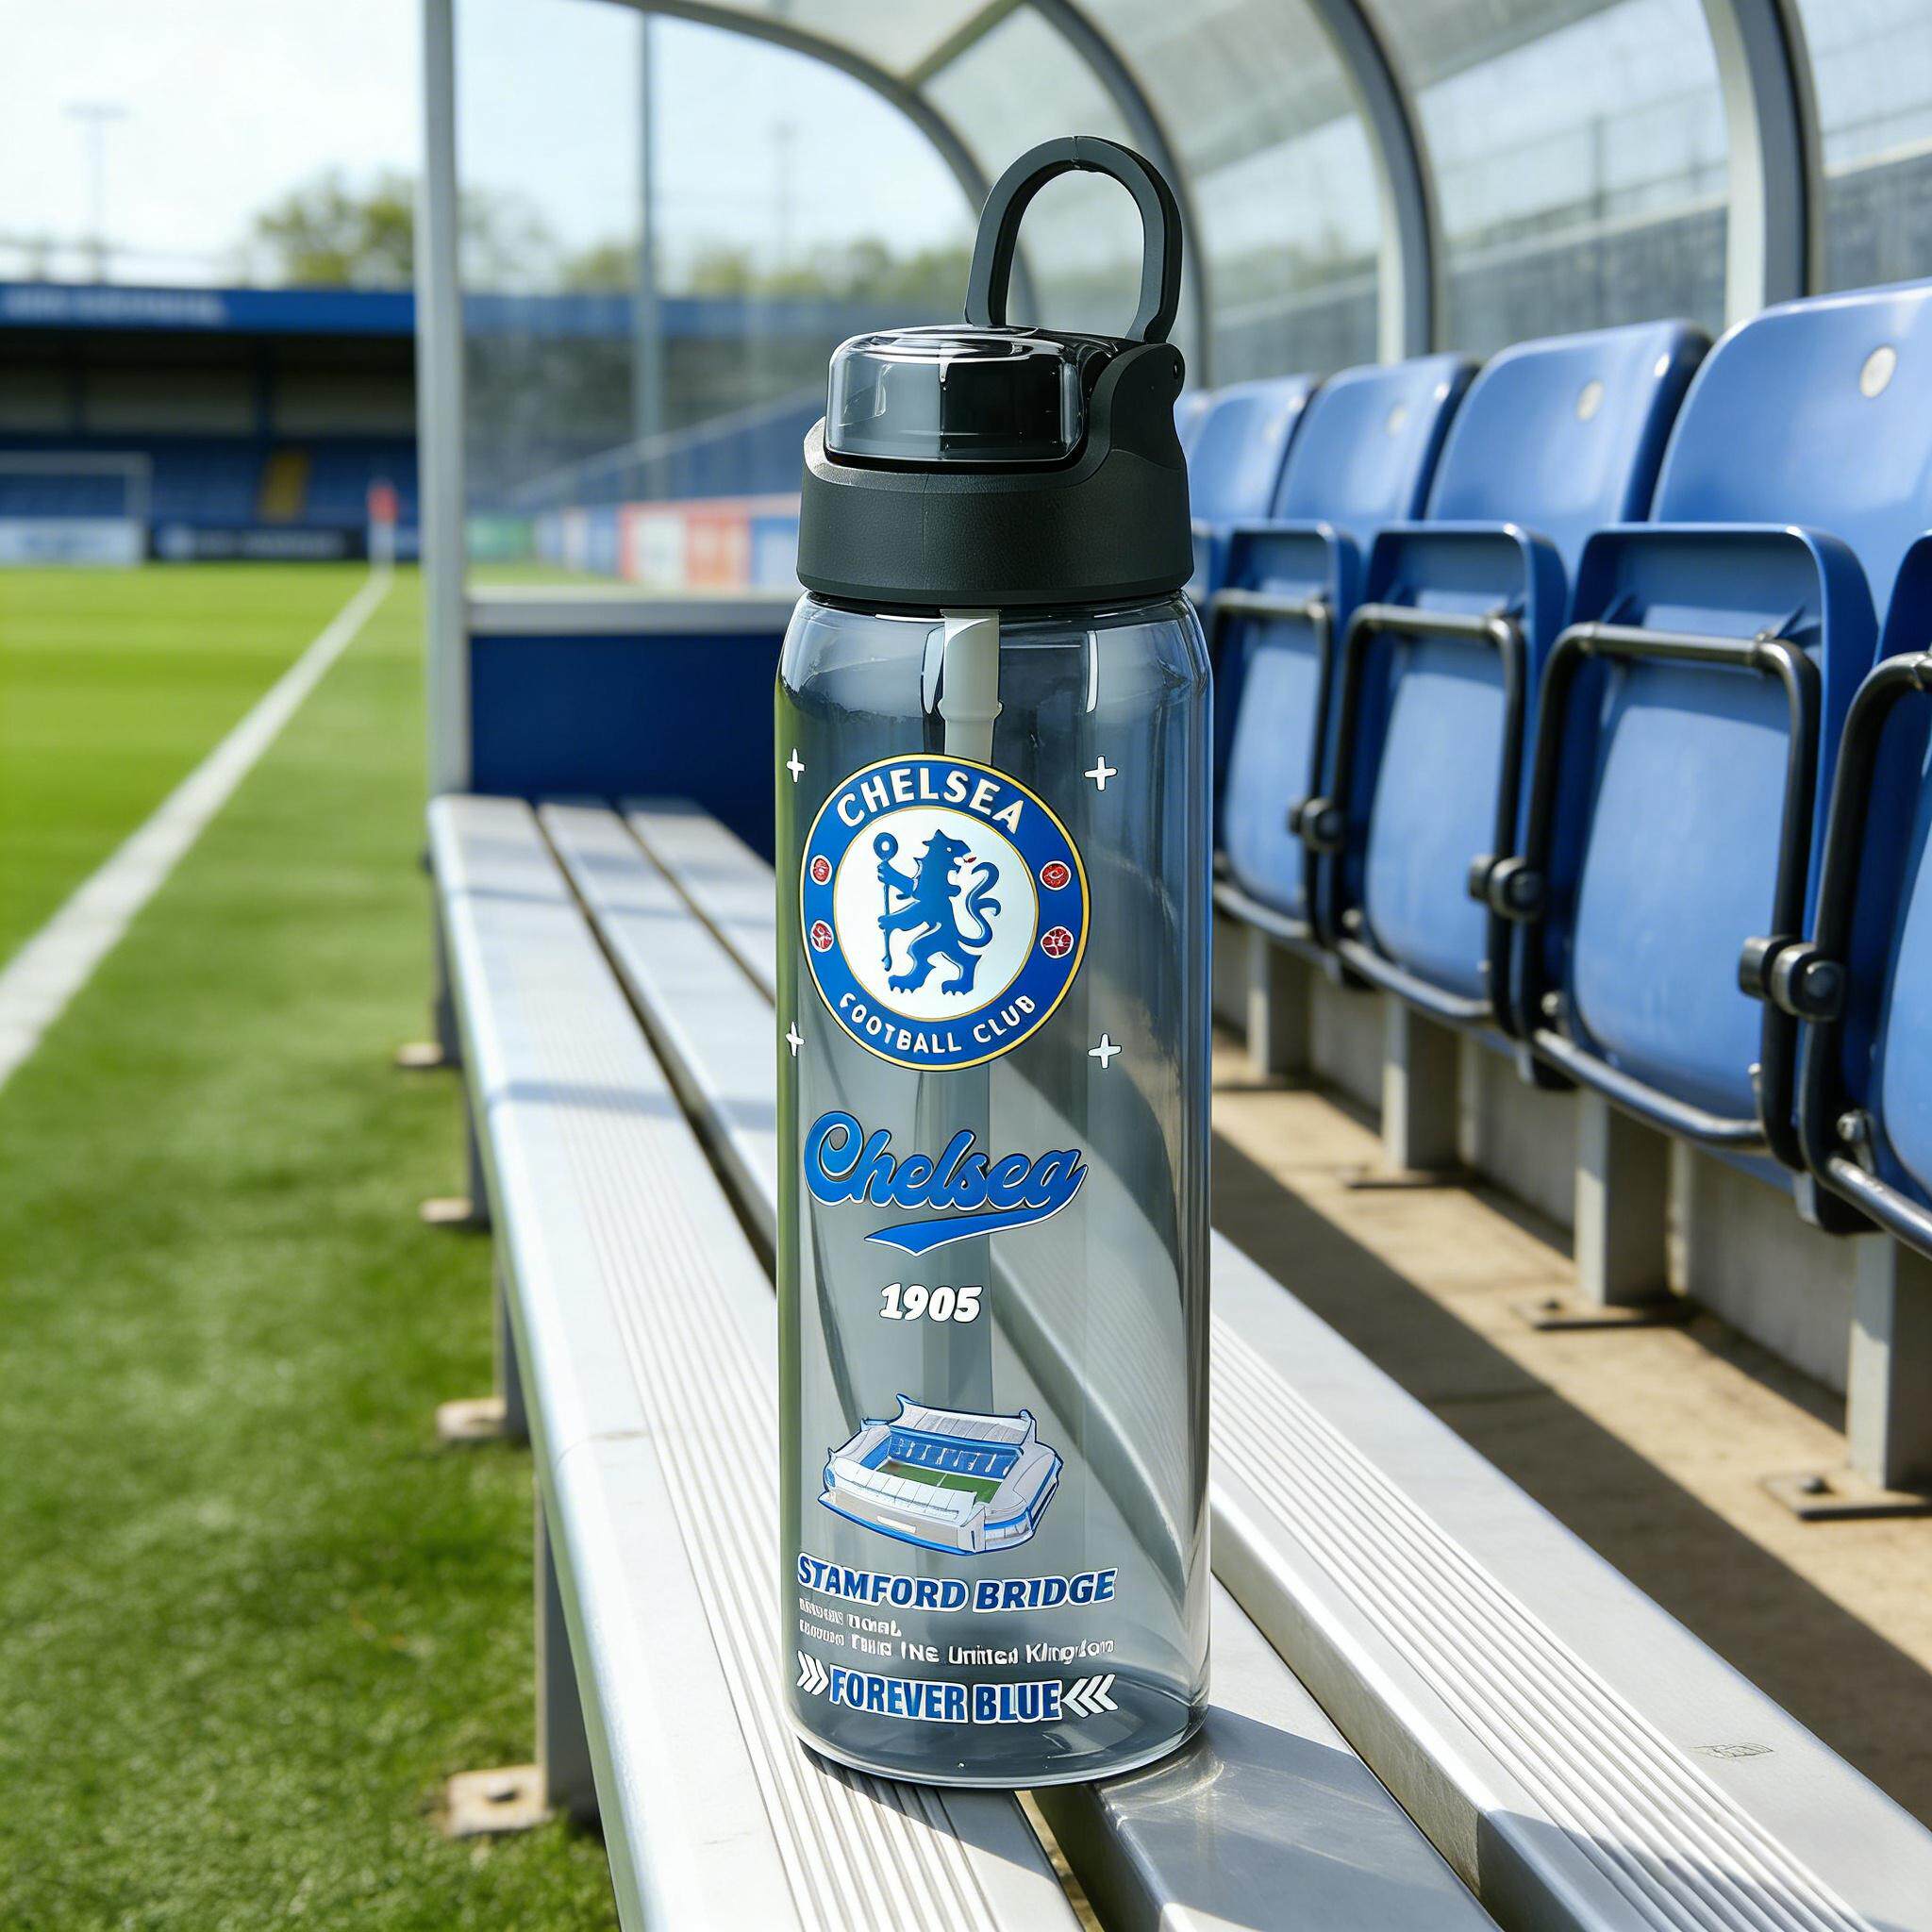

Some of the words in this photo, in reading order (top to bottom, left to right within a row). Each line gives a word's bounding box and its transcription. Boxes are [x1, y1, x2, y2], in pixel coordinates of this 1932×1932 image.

[837, 767, 1024, 835] CHELSEA
[839, 992, 962, 1054] FOOTBALL
[973, 994, 1036, 1042] CLUB
[803, 1110, 1089, 1217] Chelsea
[878, 1282, 984, 1323] 1905
[797, 1553, 970, 1612] STAMFORD
[972, 1567, 1119, 1614] BRIDGE
[828, 1664, 970, 1724] FOREVER
[973, 1680, 1063, 1724] BLUE
